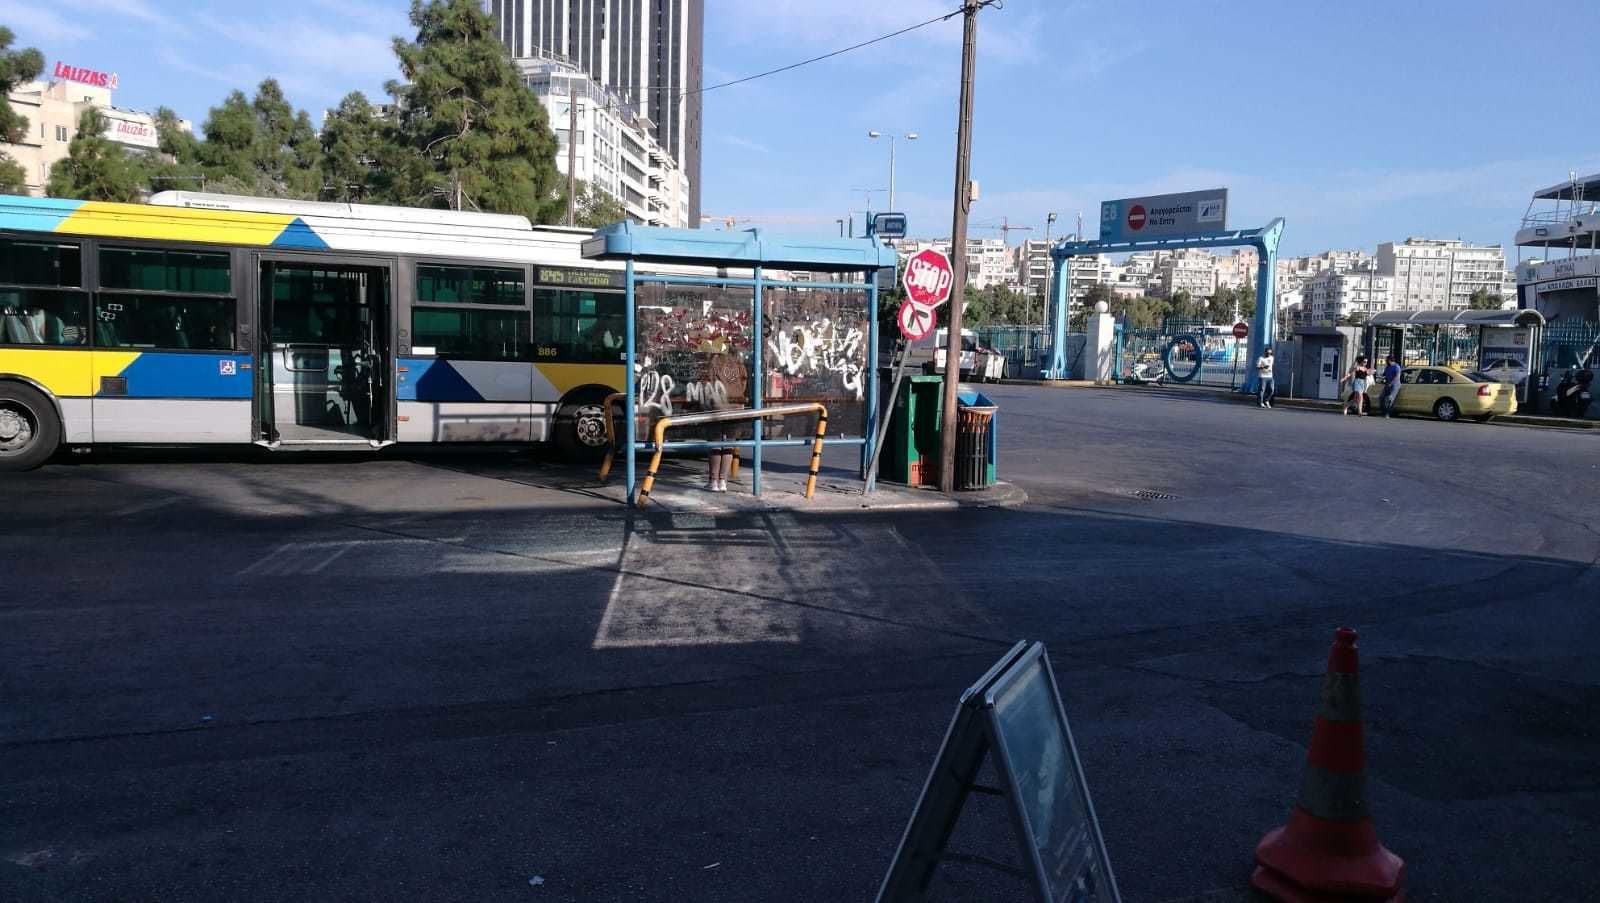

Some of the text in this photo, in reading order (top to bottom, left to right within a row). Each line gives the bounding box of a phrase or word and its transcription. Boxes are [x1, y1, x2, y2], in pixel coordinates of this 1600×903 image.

[54, 61, 108, 87] LALIZAS
[117, 121, 148, 137] LALIZAS
[1159, 217, 1175, 226] Entry
[908, 259, 950, 297] STOP
